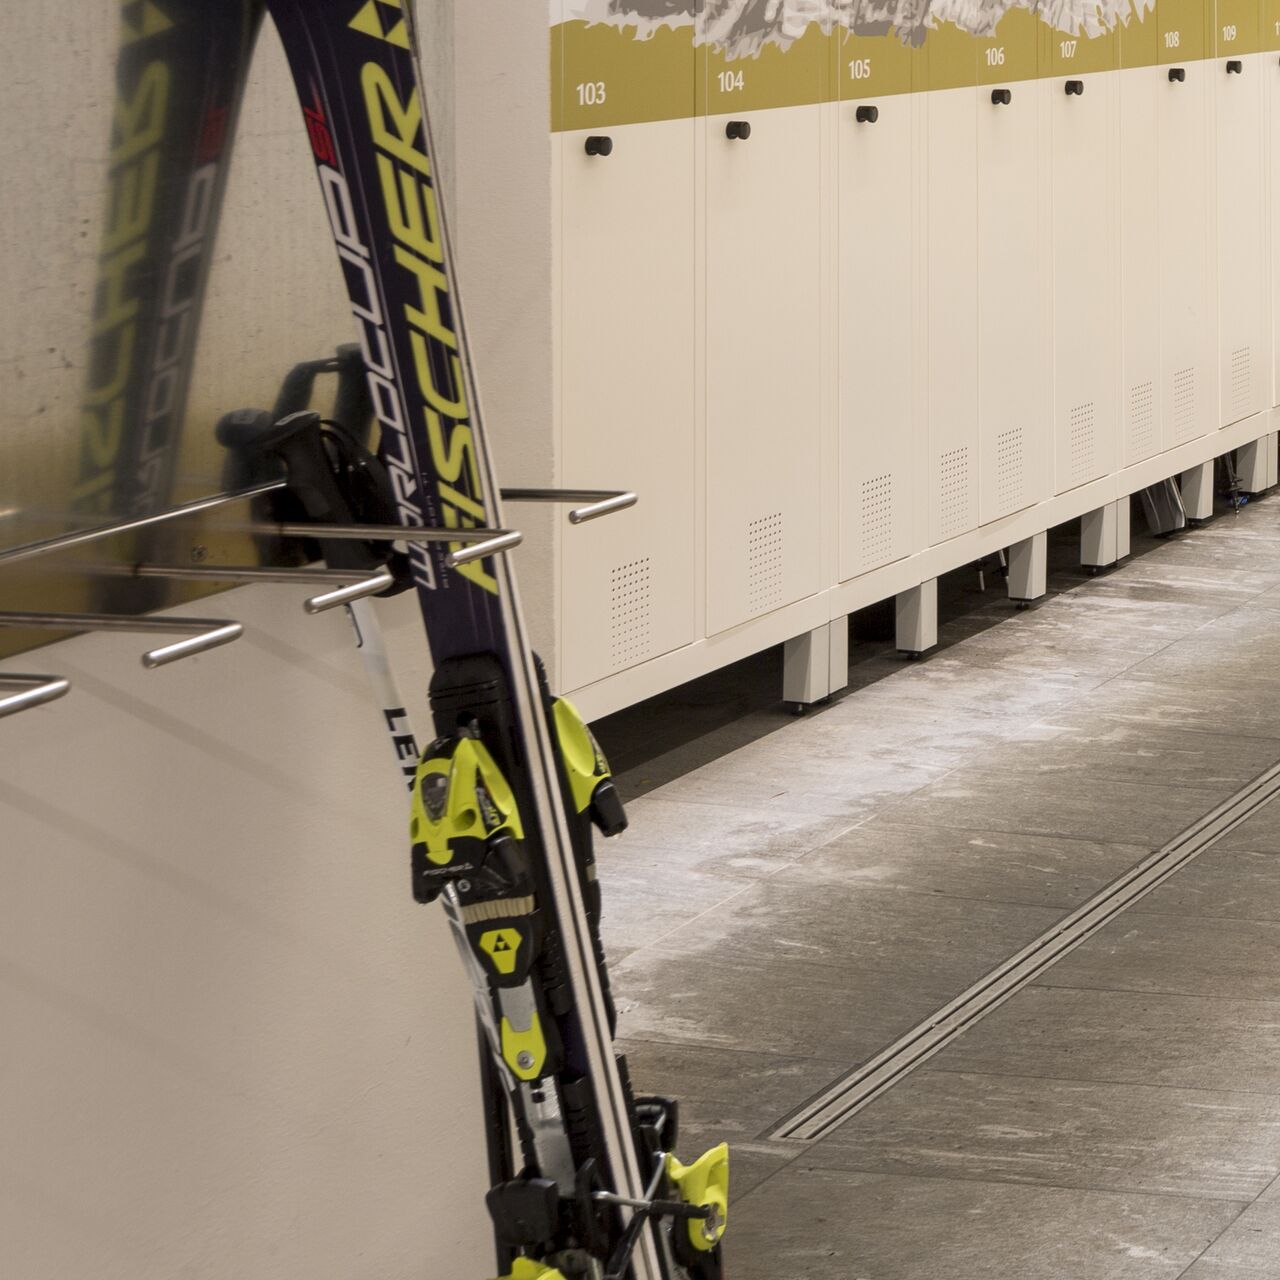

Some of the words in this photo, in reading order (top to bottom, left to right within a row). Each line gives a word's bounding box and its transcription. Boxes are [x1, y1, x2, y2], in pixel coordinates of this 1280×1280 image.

[1164, 31, 1180, 48] 108
[1222, 24, 1237, 41] 109
[984, 47, 1005, 66] 106
[1059, 40, 1078, 59] 107
[848, 58, 872, 80] 105
[717, 70, 745, 93] 104
[576, 81, 607, 106] 103
